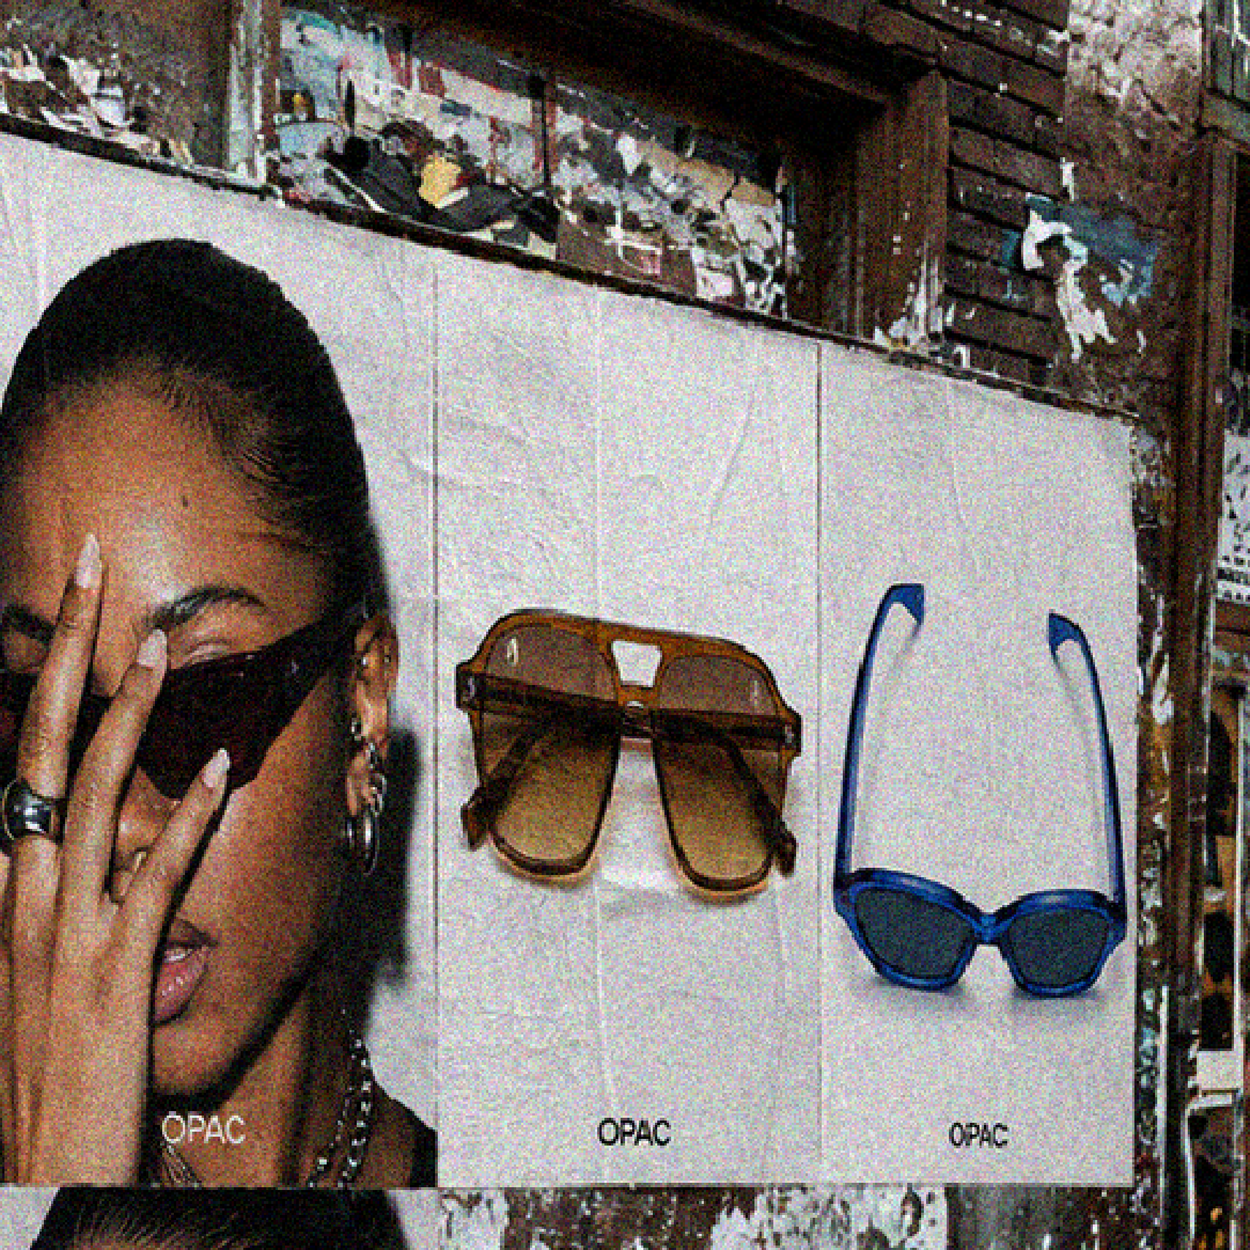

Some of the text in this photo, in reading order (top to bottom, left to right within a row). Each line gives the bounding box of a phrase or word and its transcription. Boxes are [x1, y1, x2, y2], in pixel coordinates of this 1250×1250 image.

[162, 1112, 246, 1145] OPAC
[598, 1117, 671, 1147] OPAC
[950, 1122, 1009, 1148] OPAC
